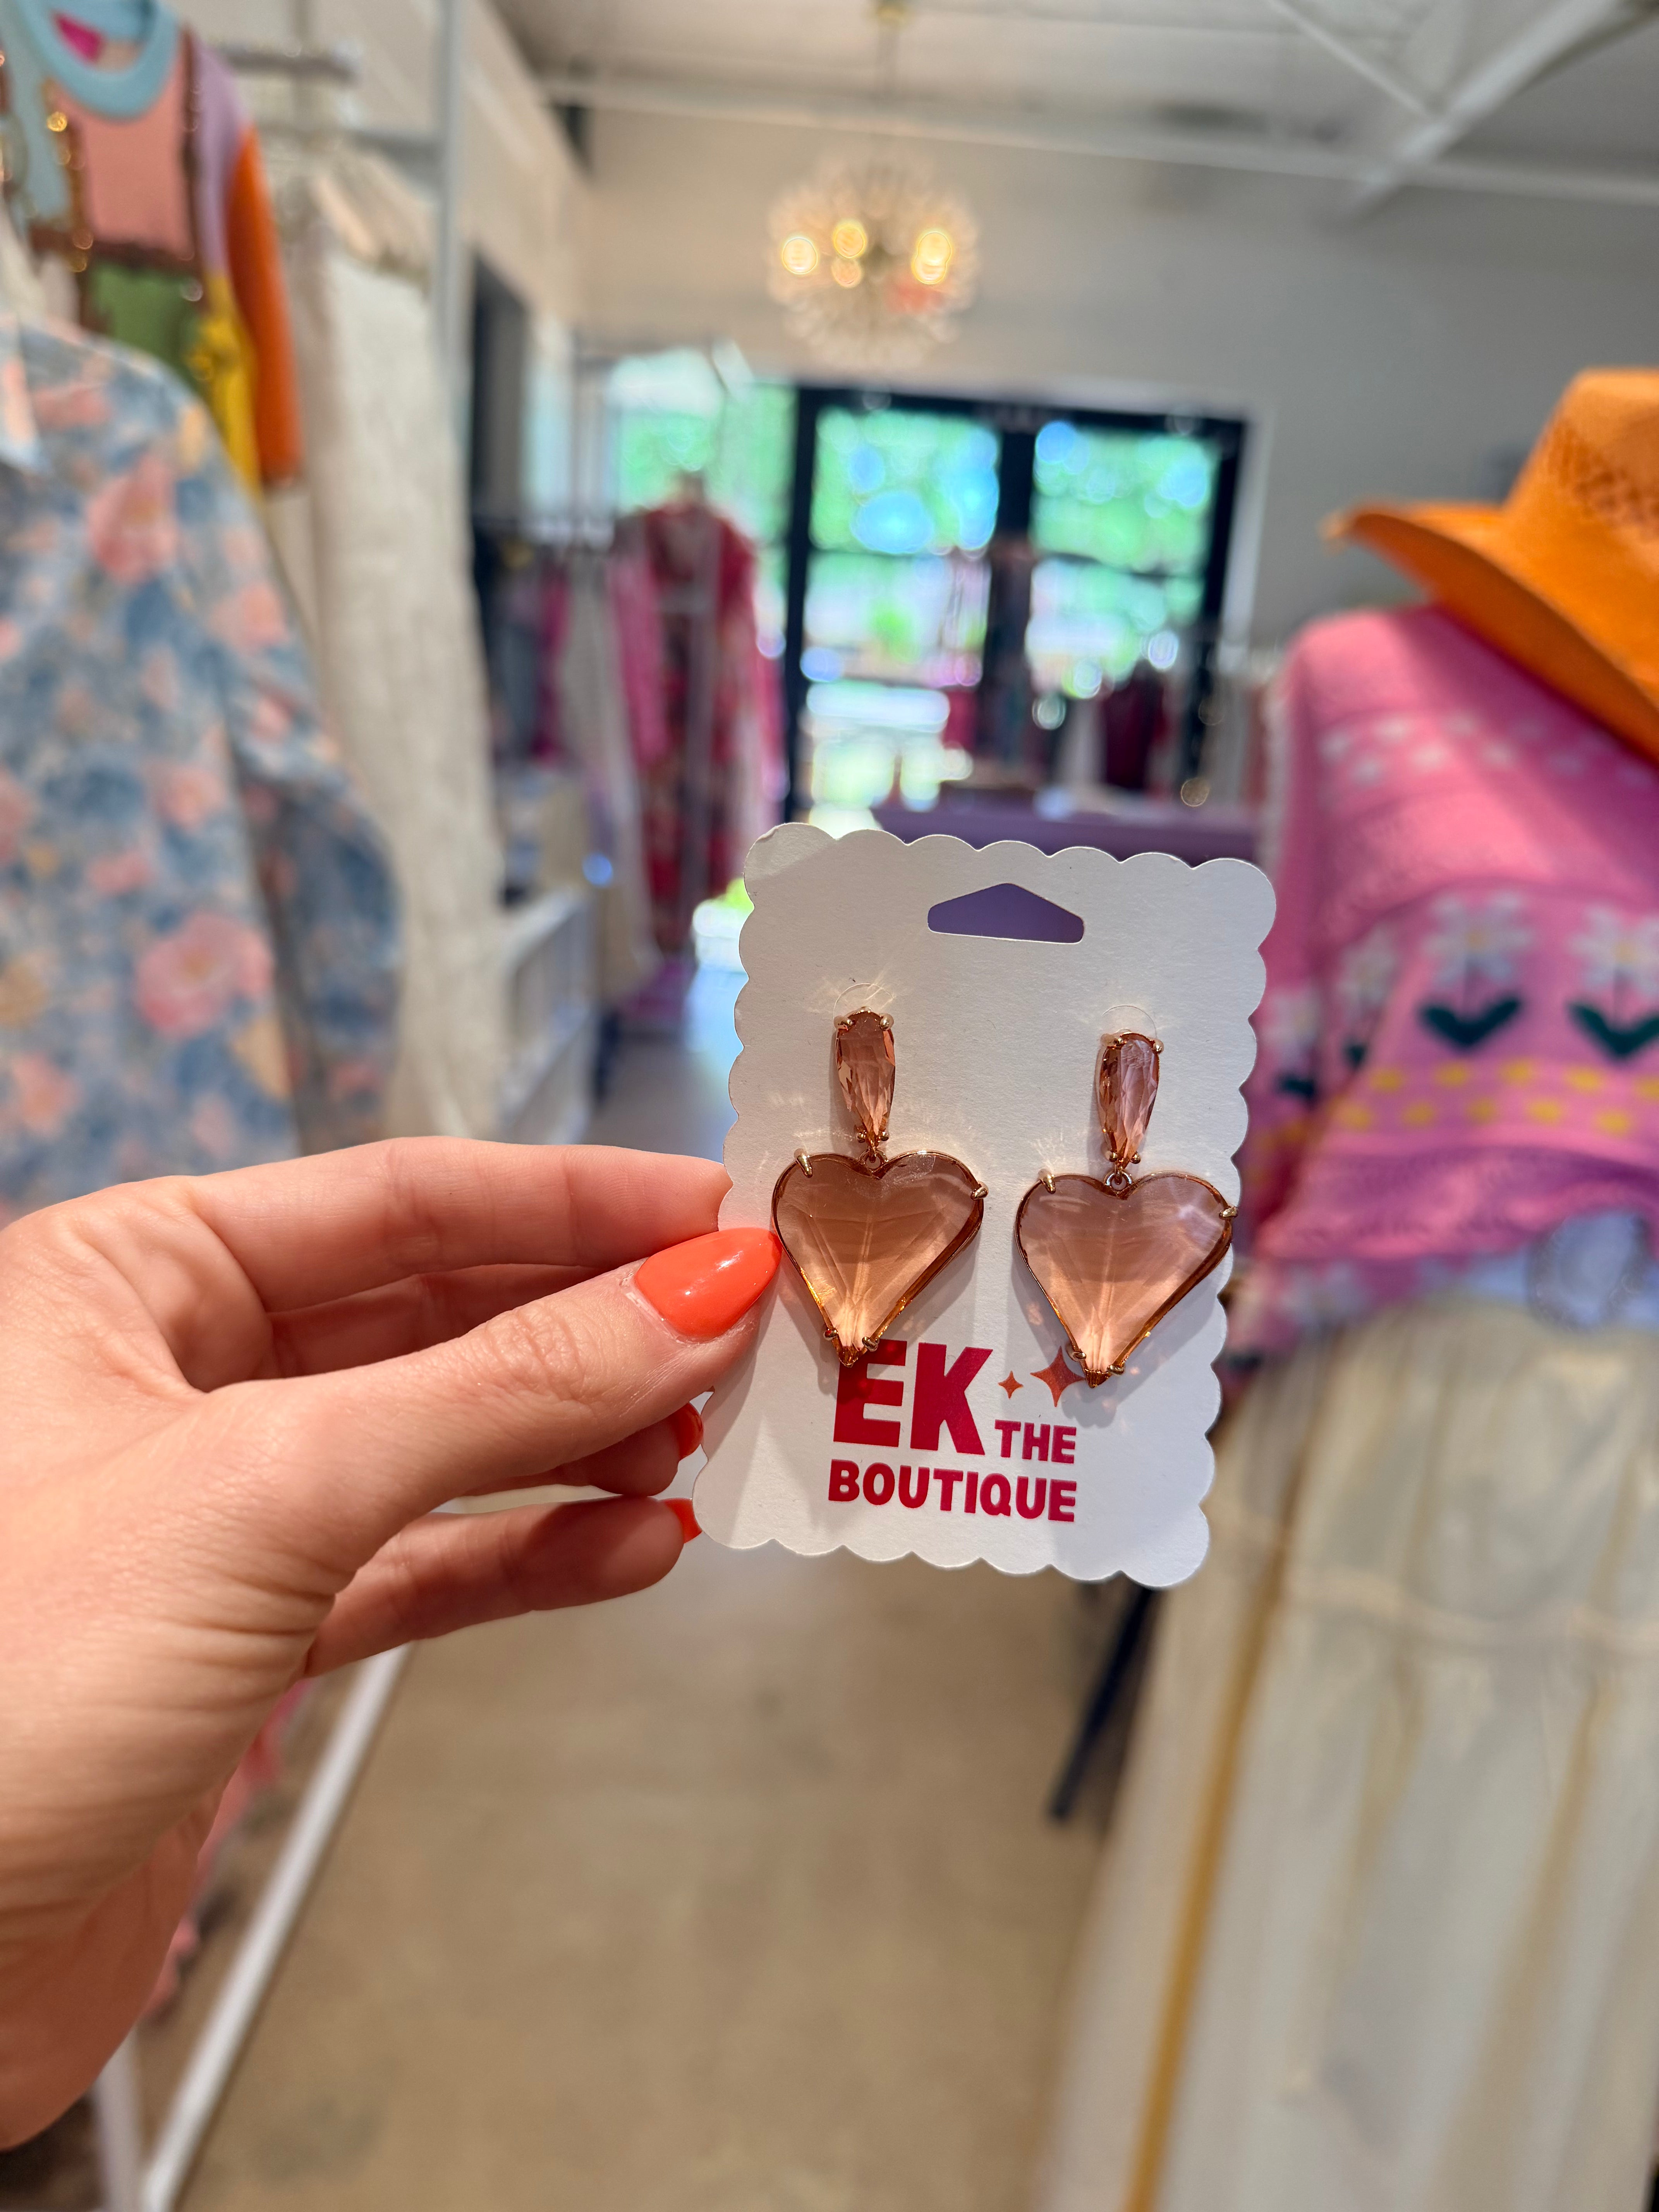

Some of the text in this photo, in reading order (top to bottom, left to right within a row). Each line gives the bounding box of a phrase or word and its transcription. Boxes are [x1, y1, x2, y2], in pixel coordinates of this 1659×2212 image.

[833, 1338, 1077, 1464] EK THE
[828, 1459, 1077, 1522] BOUTIQUE
